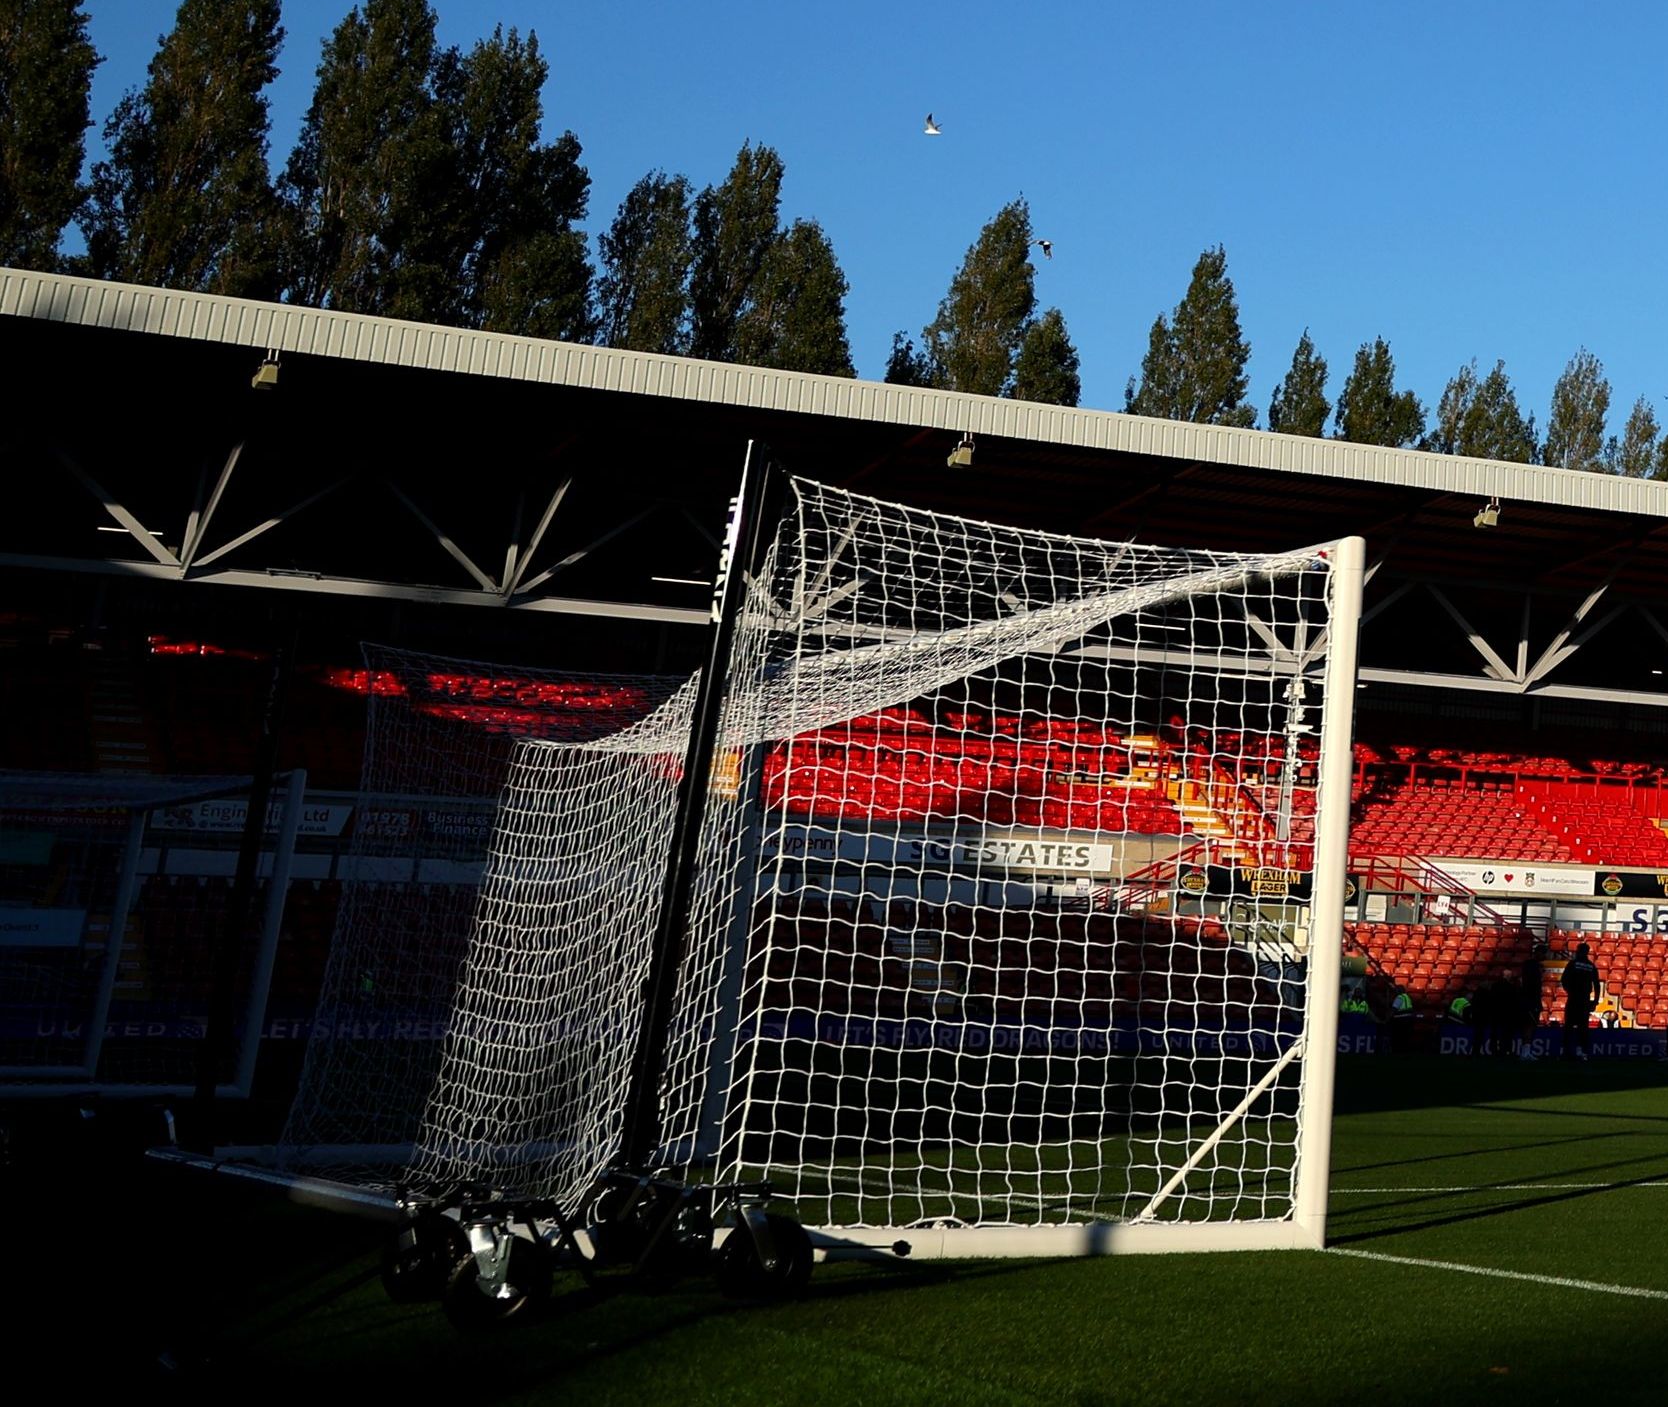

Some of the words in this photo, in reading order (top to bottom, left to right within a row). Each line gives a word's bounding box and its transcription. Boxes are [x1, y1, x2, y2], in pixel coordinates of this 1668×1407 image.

[303, 809, 330, 822] Ltd
[910, 837, 951, 861] SG
[963, 839, 1090, 867] ESTATES
[1240, 868, 1302, 884] WREXHAM
[1254, 882, 1286, 892] LAGER
[1151, 1034, 1239, 1050] UNITED
[1592, 1042, 1653, 1056] NITED
